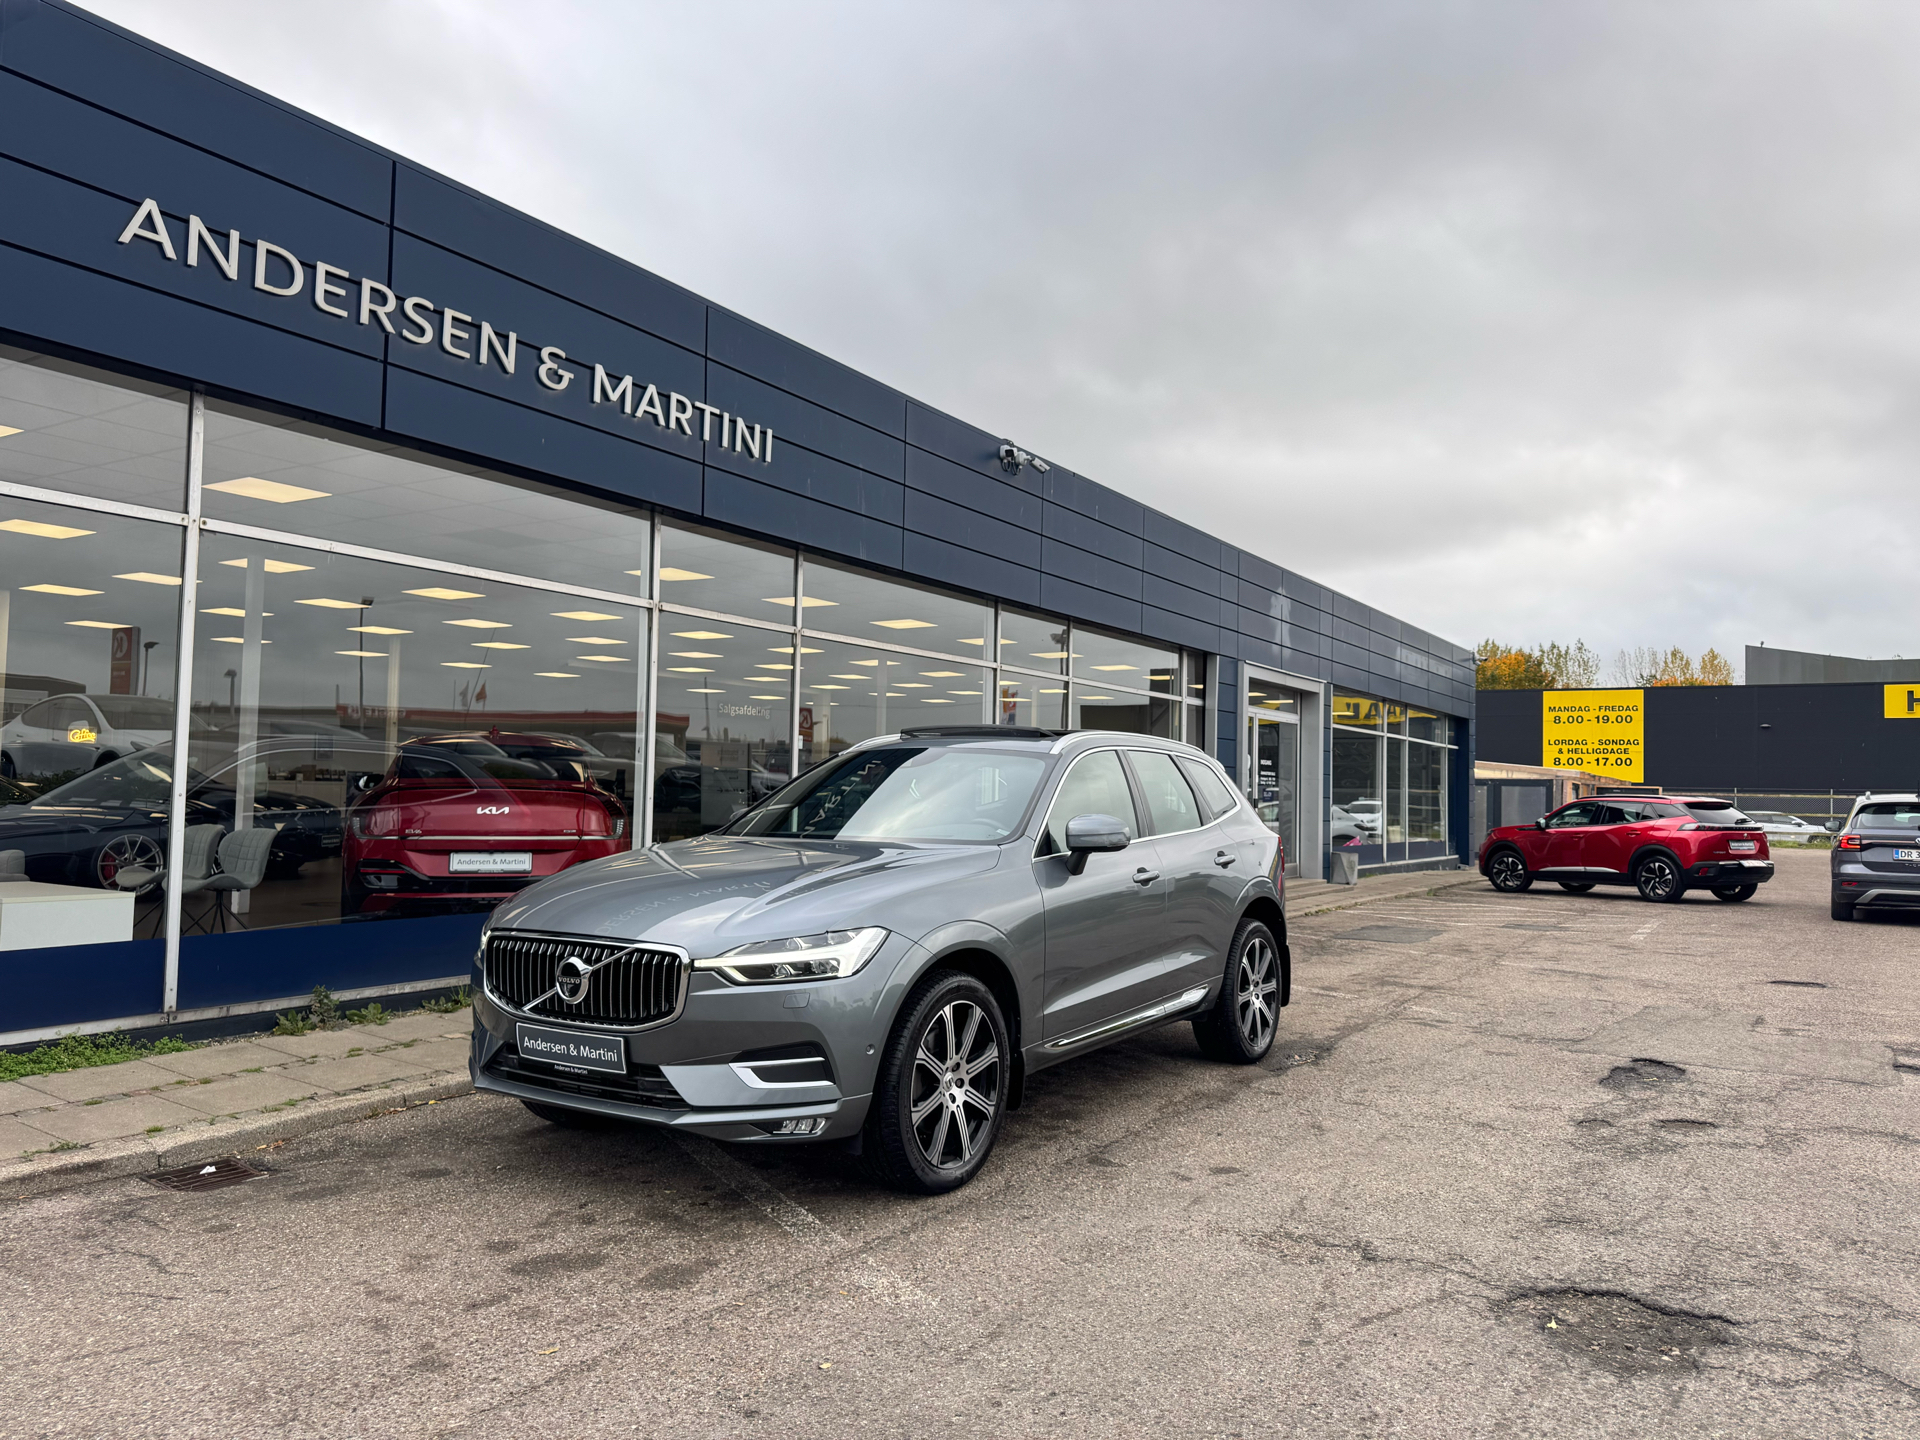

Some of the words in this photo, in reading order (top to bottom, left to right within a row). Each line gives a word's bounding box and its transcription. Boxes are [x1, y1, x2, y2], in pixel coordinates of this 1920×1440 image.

[118, 197, 517, 375] ANDERSEN
[538, 345, 574, 391] &
[592, 363, 773, 464] MARTINI
[718, 703, 771, 720] Salgsafdeling
[1548, 705, 1591, 713] MANDAG
[1553, 715, 1584, 724] 8.00
[1594, 714, 1633, 724] 19.00
[1557, 747, 1564, 755] &
[1567, 747, 1630, 755] HELLIGDAGE
[1553, 757, 1584, 766] 8.00
[1594, 757, 1633, 766] 17.00
[476, 806, 510, 815] KIA
[1900, 850, 1913, 858] DR
[457, 857, 491, 866] Andersen
[499, 857, 526, 866] Martini
[558, 976, 581, 984] VOLVO
[523, 1036, 568, 1055] Andersen
[569, 1043, 578, 1056] &
[580, 1045, 618, 1062] Martini
